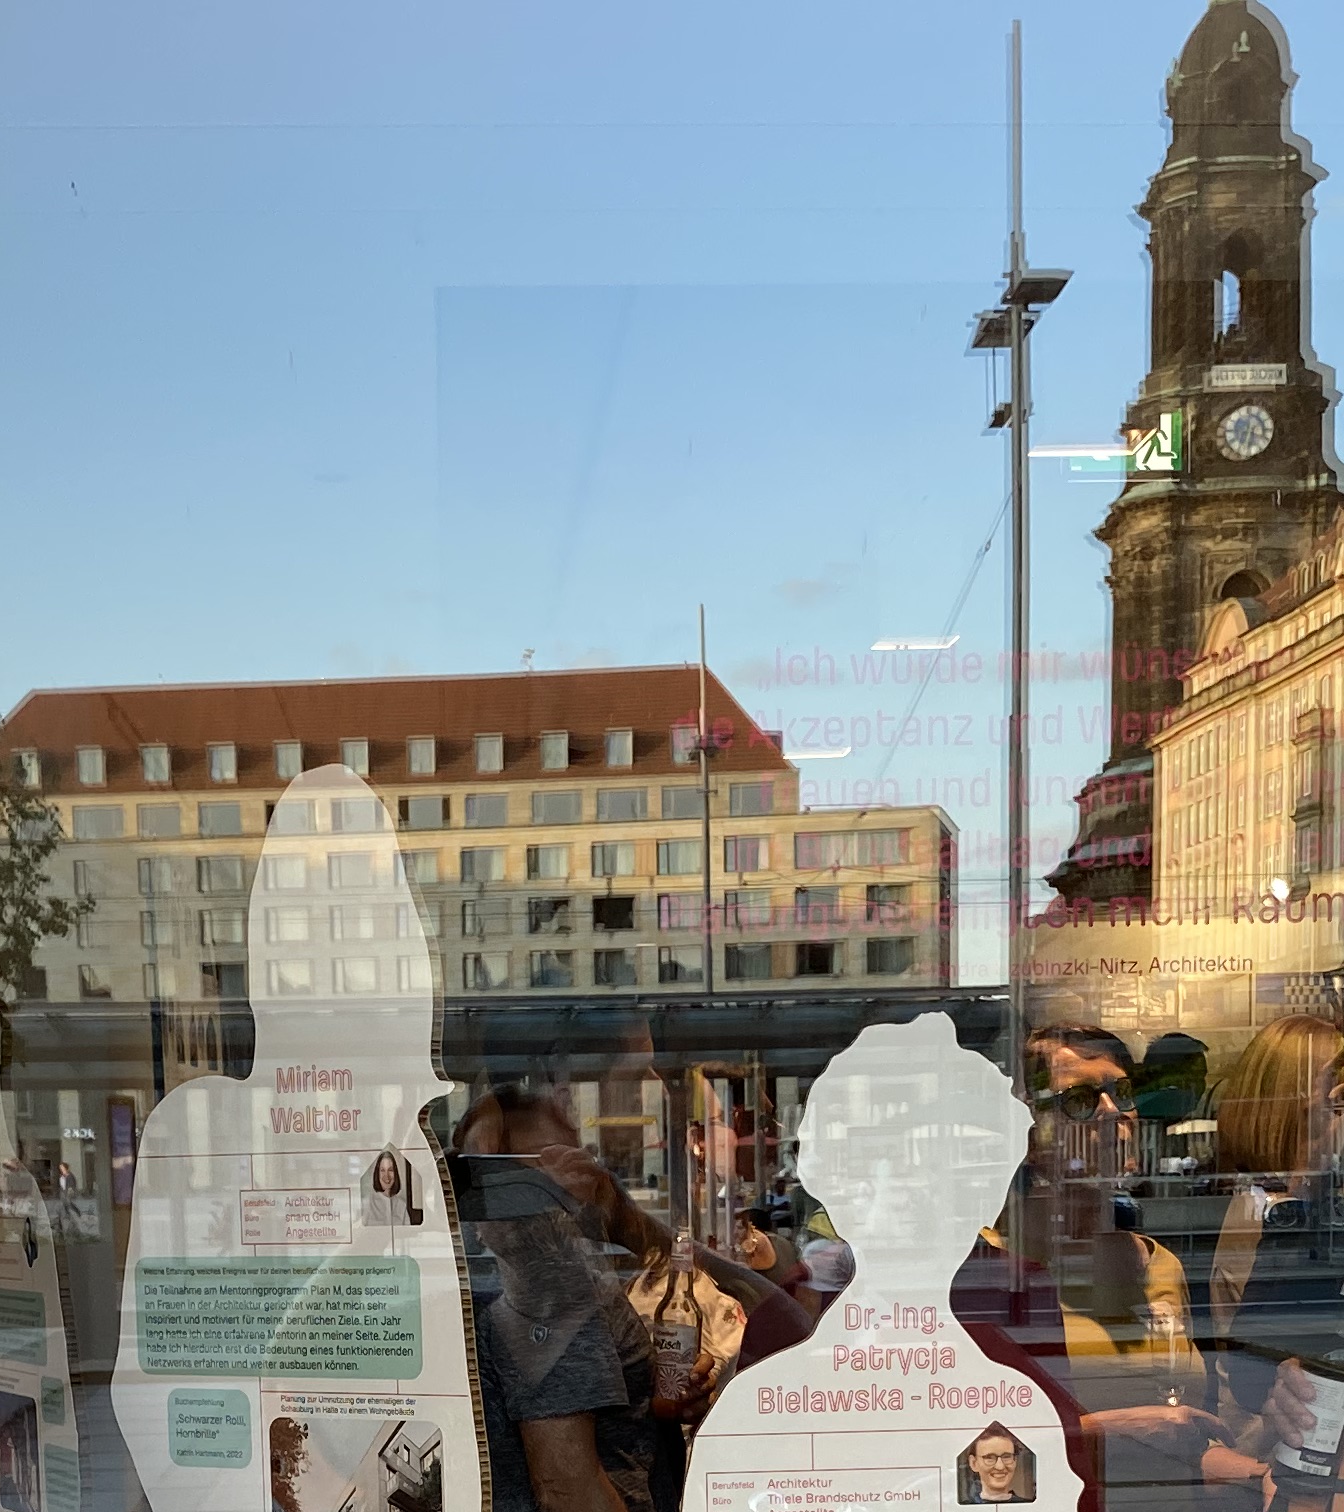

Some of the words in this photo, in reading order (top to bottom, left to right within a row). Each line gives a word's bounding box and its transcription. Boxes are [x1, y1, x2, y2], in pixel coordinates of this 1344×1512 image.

[851, 646, 983, 686] würde
[927, 767, 991, 808] und
[1148, 955, 1253, 973] Architektin
[275, 1066, 353, 1094] Miriam
[270, 1106, 361, 1134] Walther
[844, 1302, 944, 1335] Dr.-Ing.
[833, 1343, 956, 1375] Patrycja
[758, 1383, 903, 1415] Bielawska
[928, 1380, 1032, 1414] Roepke
[768, 1476, 833, 1490] Architektur
[768, 1491, 803, 1505] Thiele
[804, 1491, 881, 1504] Brandschutz
[885, 1489, 920, 1502] GmbH
